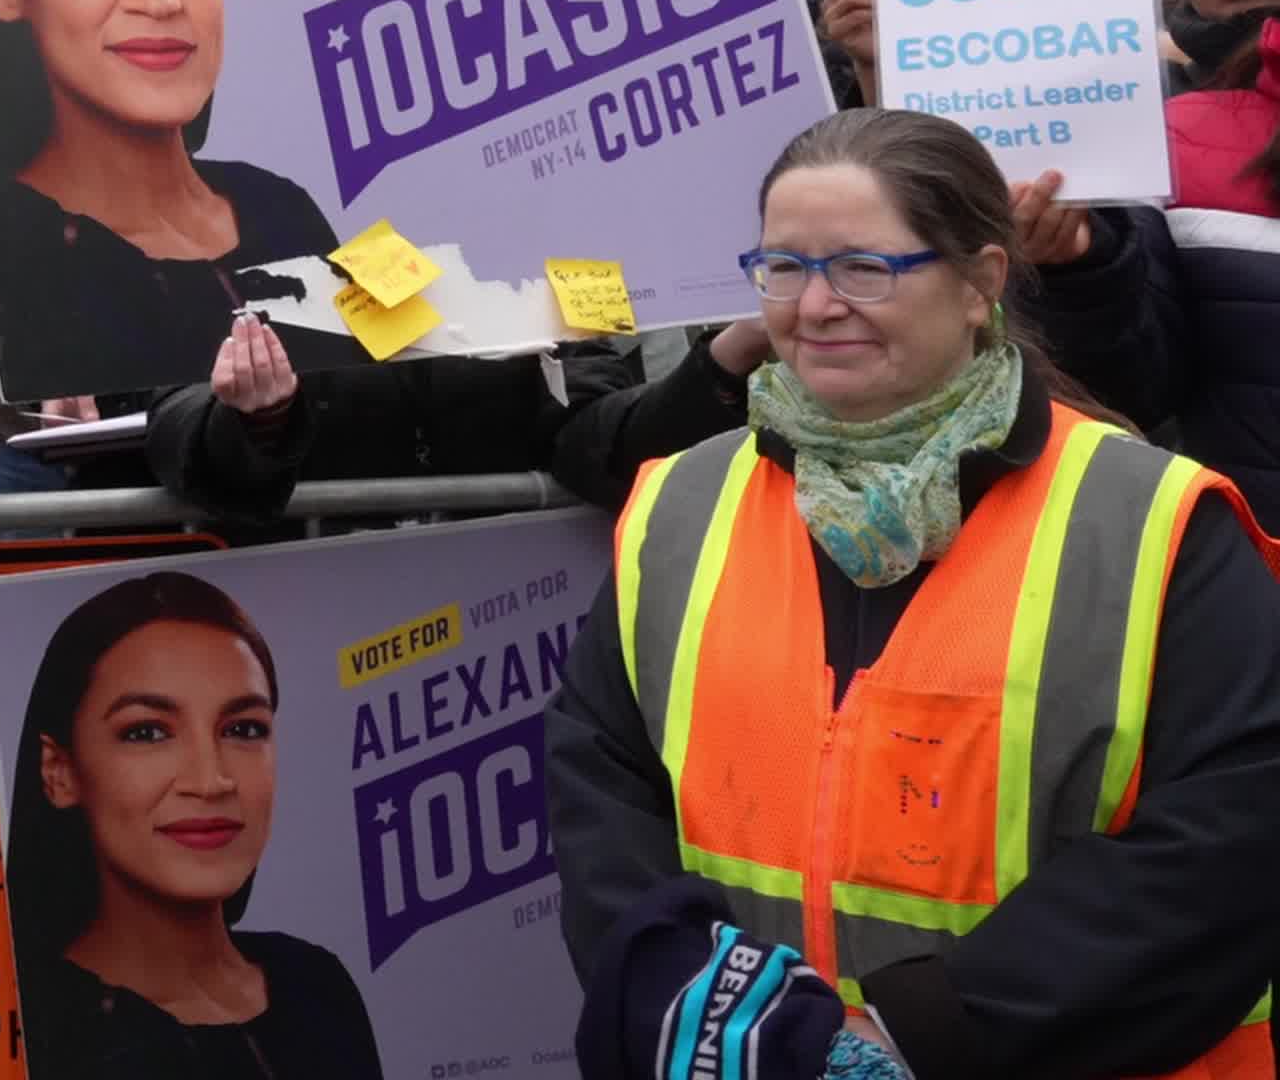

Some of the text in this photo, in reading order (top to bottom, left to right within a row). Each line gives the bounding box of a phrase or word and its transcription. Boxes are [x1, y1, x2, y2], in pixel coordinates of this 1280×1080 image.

[897, 18, 1142, 71] ESCOBAR
[481, 19, 800, 169] DEMOCRAT CORTEZ
[904, 78, 1140, 116] District Leader
[973, 121, 1072, 149] Part B
[531, 139, 587, 181] NY-14
[351, 569, 569, 675] VOTE FOR VOTA POR
